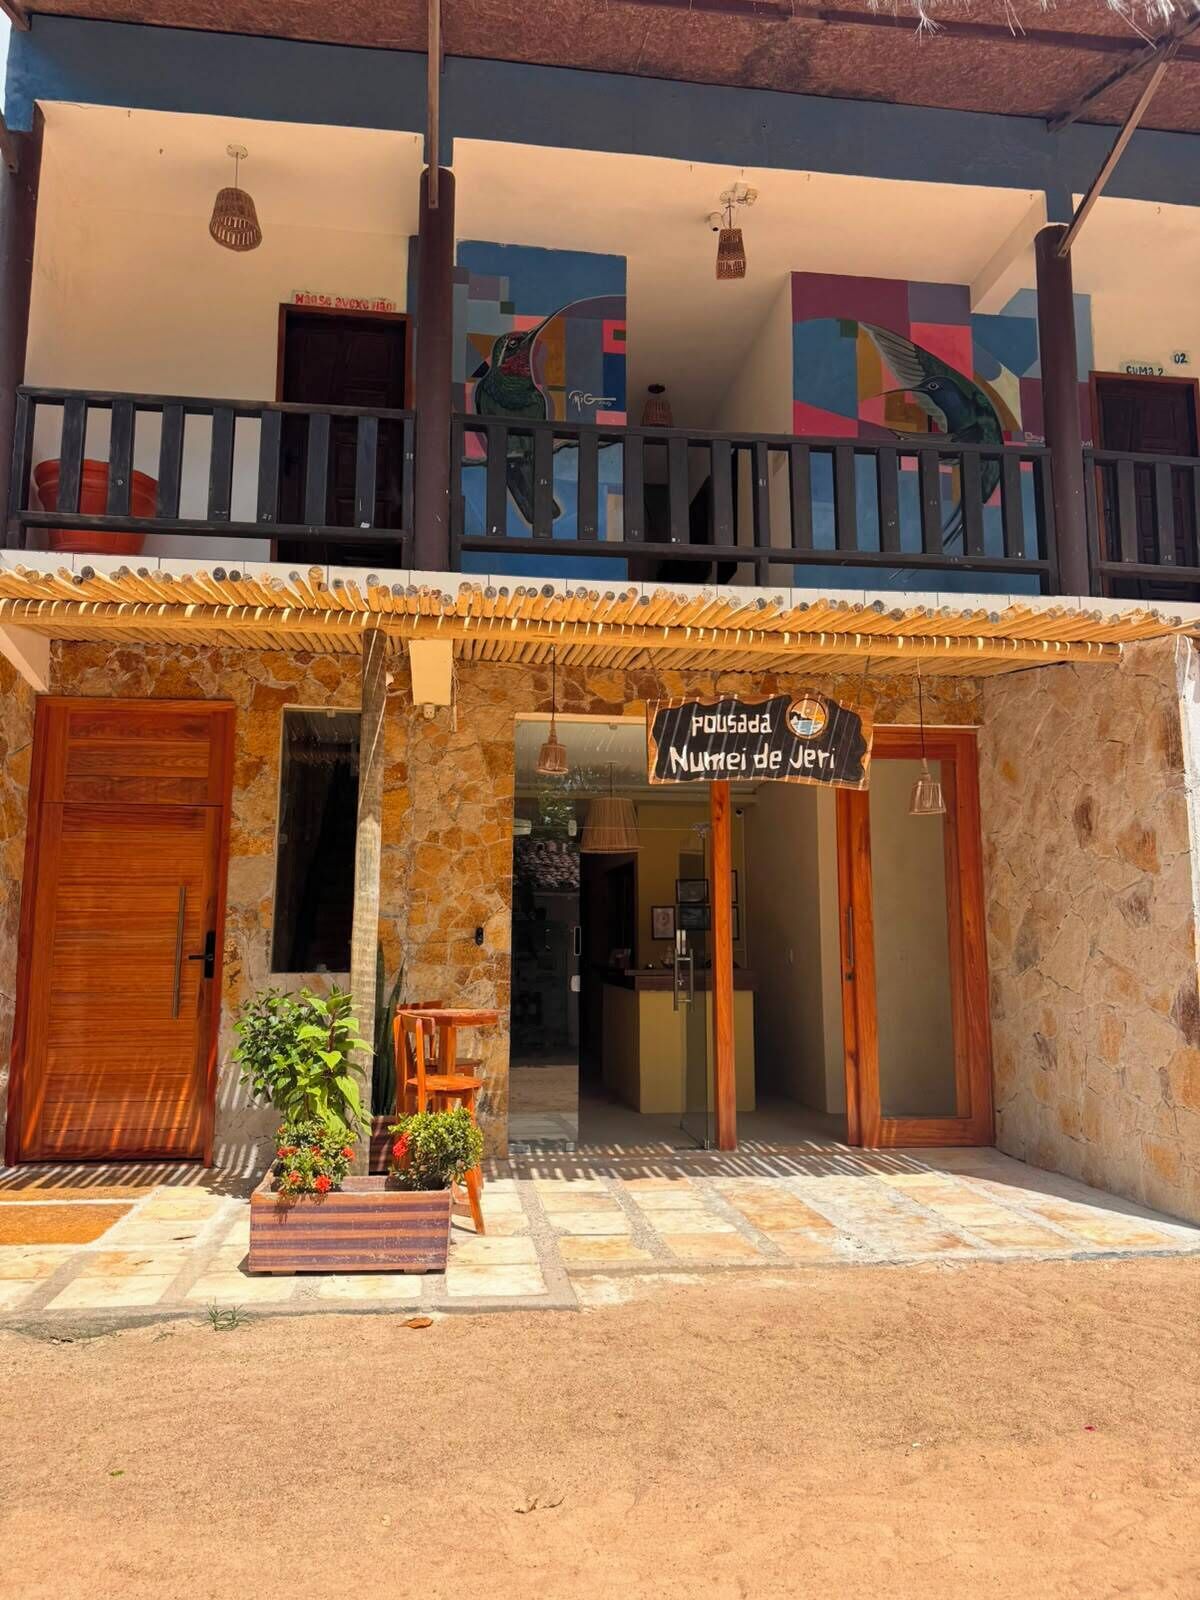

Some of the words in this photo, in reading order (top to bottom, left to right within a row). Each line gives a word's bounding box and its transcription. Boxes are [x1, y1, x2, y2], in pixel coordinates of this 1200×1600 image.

[1173, 353, 1188, 364] 02
[669, 745, 747, 774] Numei
[753, 743, 783, 770] de
[789, 745, 836, 769] Jeri
